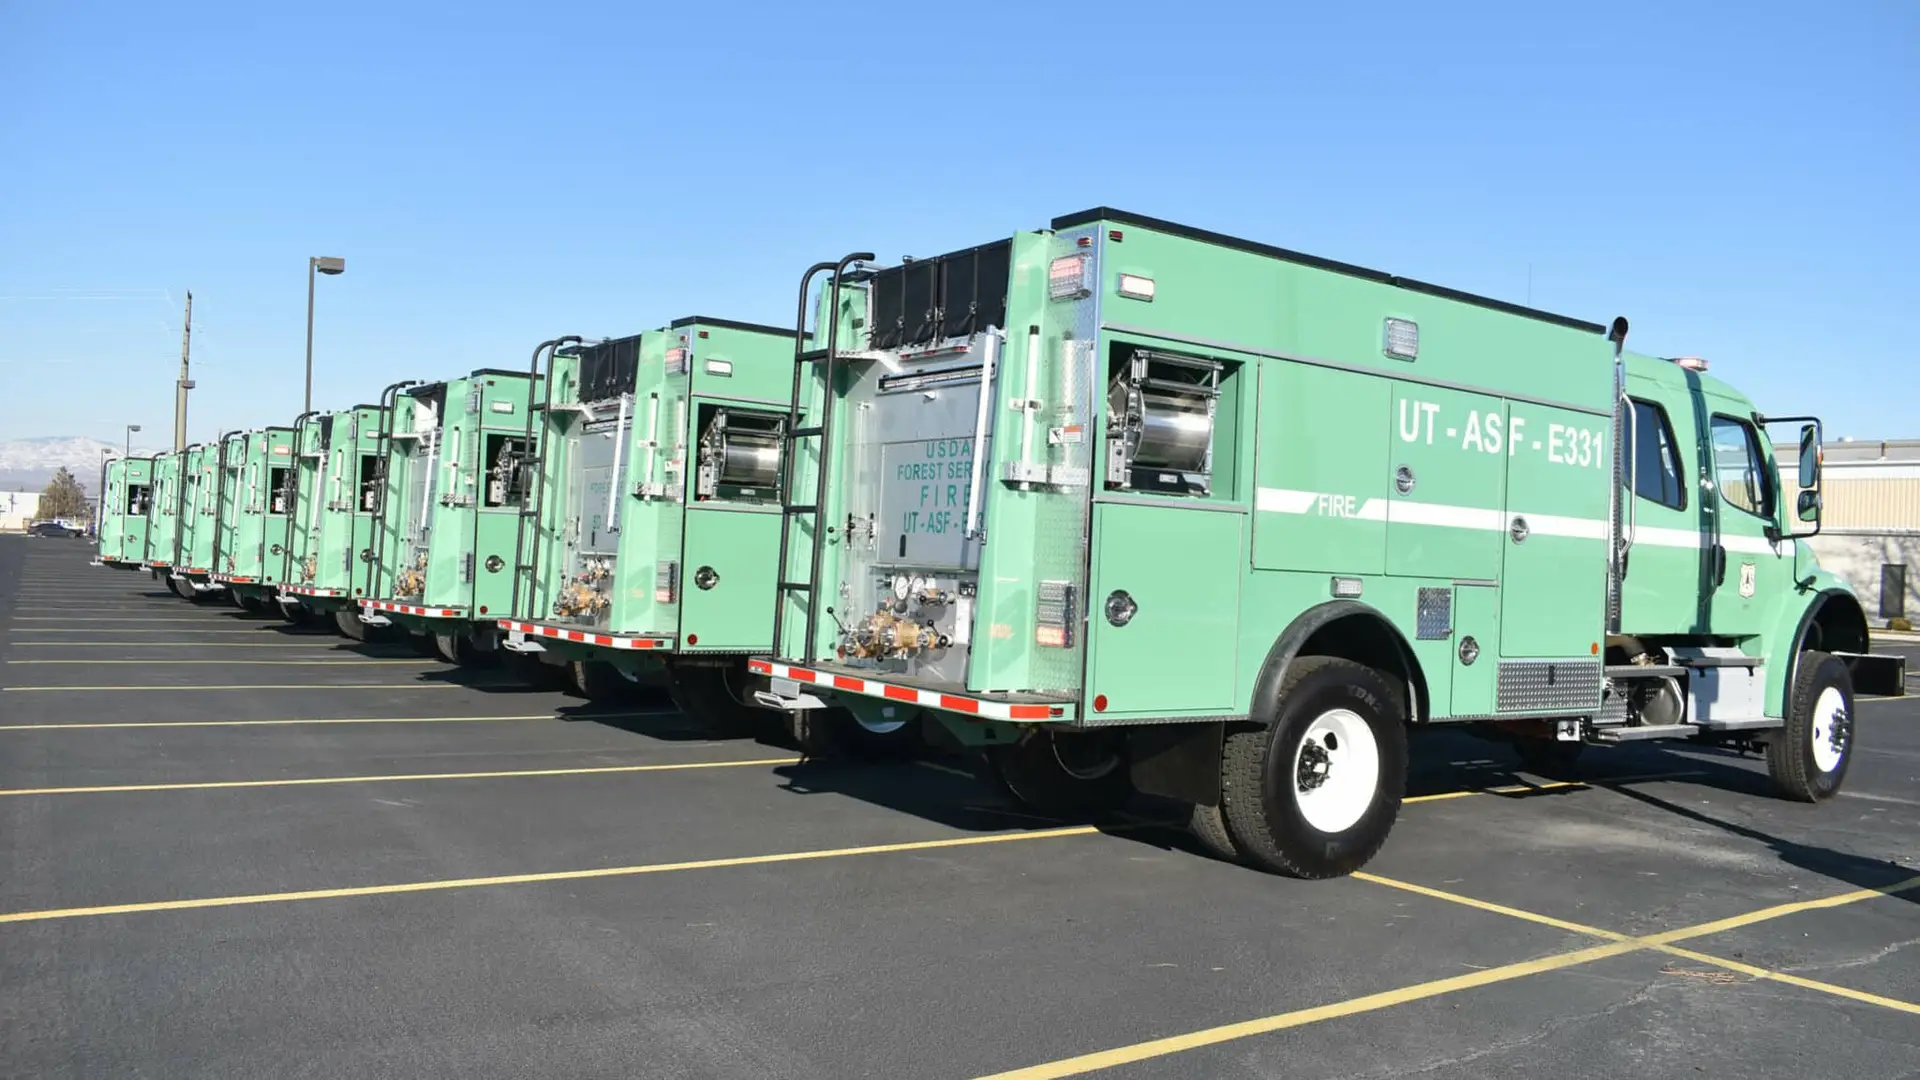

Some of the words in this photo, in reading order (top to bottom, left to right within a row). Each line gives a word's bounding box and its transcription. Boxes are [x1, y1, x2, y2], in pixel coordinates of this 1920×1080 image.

[1399, 399, 1440, 445] UT
[1462, 410, 1525, 456] ASF
[1548, 423, 1602, 469] E331
[926, 440, 970, 458] USDA
[897, 462, 944, 481] FOREST
[1318, 494, 1356, 518] FIRE
[903, 511, 919, 534] UT
[926, 511, 951, 534] ASF
